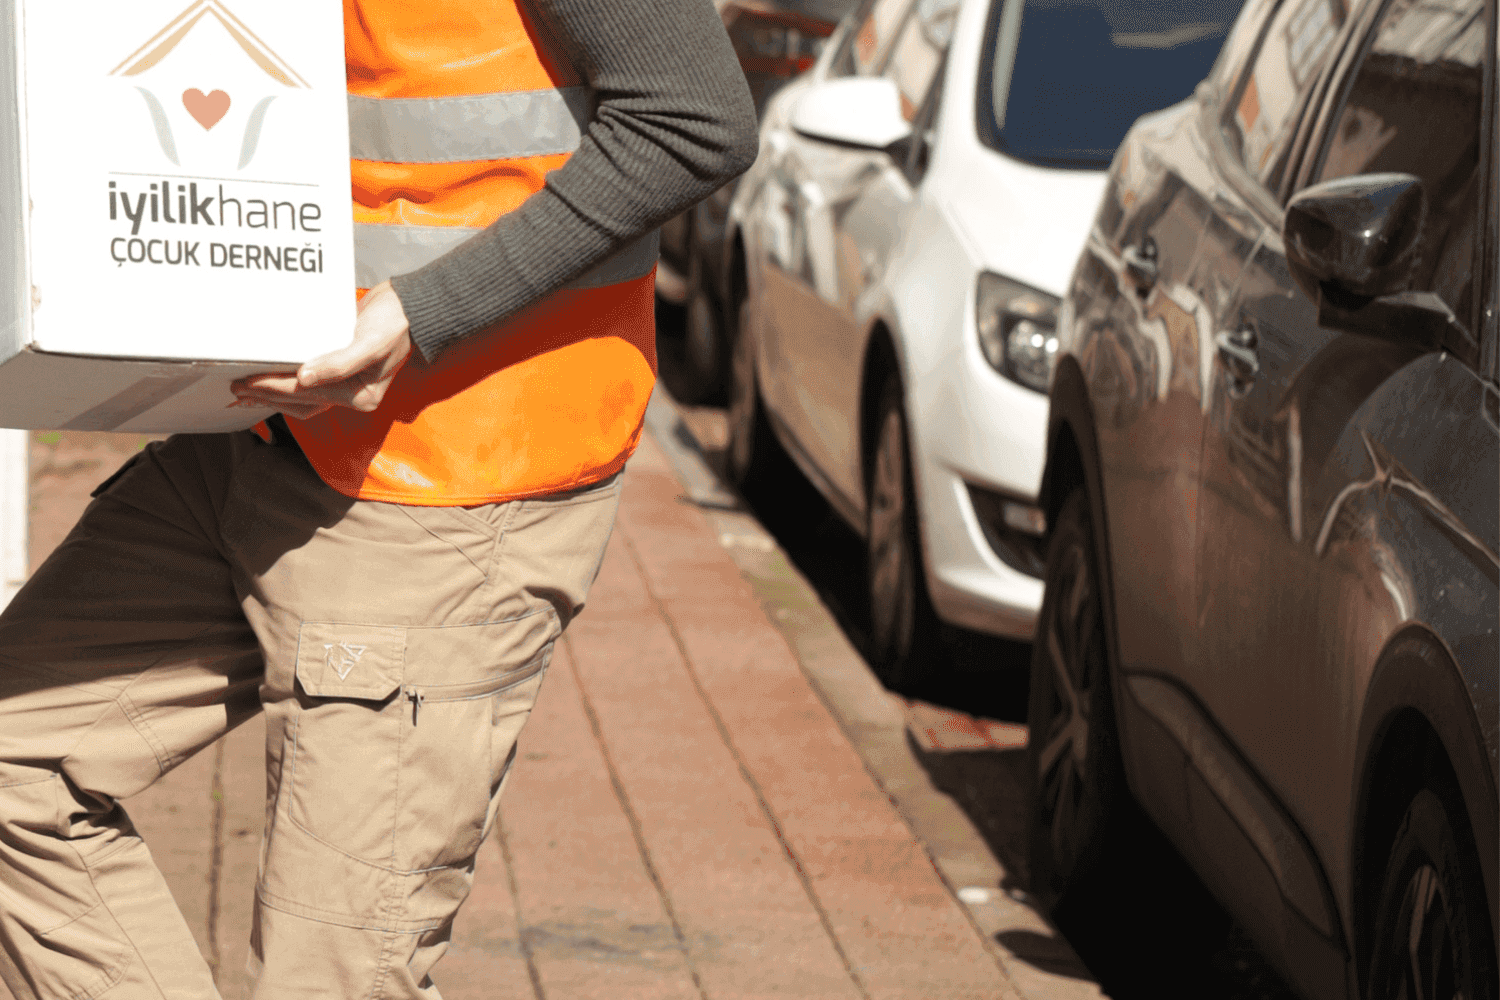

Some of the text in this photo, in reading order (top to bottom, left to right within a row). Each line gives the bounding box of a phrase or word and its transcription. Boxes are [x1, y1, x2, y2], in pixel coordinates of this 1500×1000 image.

[108, 180, 322, 236] iyilikhane
[110, 237, 323, 274] ÇOCUK DERNEĞİ
